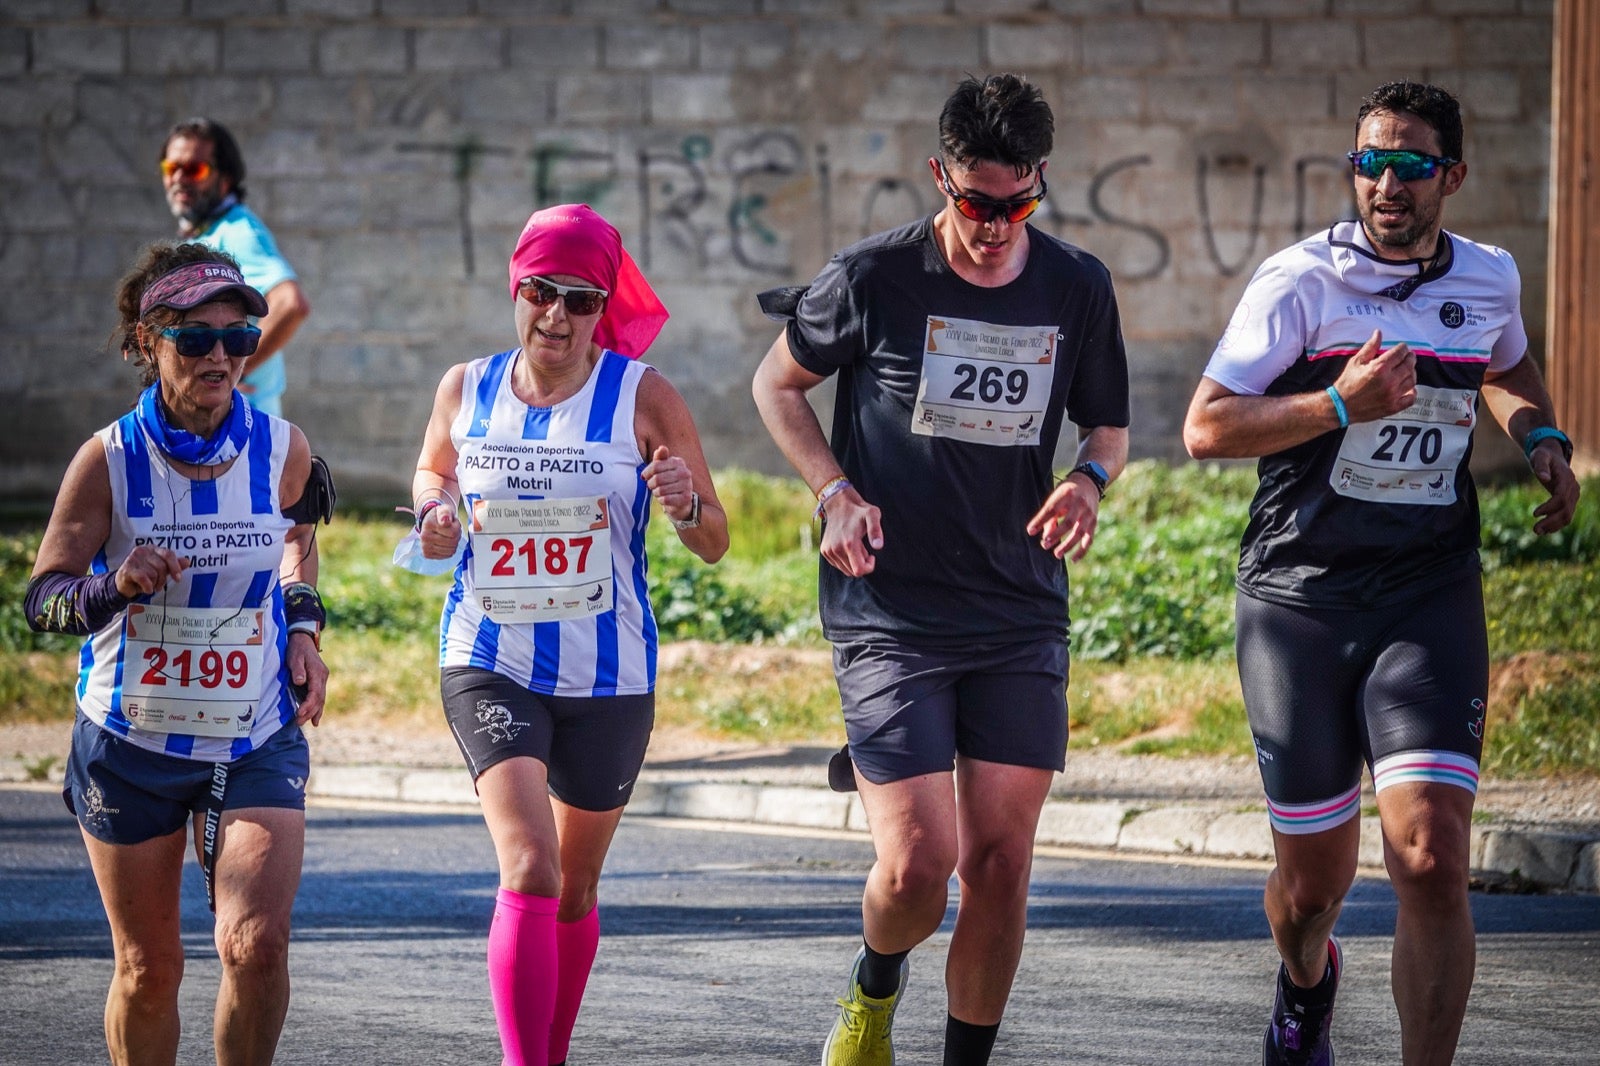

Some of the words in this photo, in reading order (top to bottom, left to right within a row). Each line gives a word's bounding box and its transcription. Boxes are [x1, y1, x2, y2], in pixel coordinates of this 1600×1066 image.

[950, 363, 1029, 406] 269
[481, 443, 534, 454] Asociación
[536, 445, 585, 456] Deportiva
[1370, 424, 1443, 465] 270
[465, 455, 520, 471] PAZITO
[524, 461, 535, 472] a
[540, 459, 604, 475] PAZITO
[507, 476, 552, 490] Motril
[573, 505, 591, 517] 2022
[151, 521, 208, 533] Asociación
[210, 520, 255, 532] Deportiva
[202, 539, 212, 549] a
[216, 533, 273, 549] PAZITO
[184, 553, 228, 569] Motril
[491, 535, 594, 577] 2187
[140, 646, 249, 689] 2199
[204, 808, 220, 856] ALCOTT
